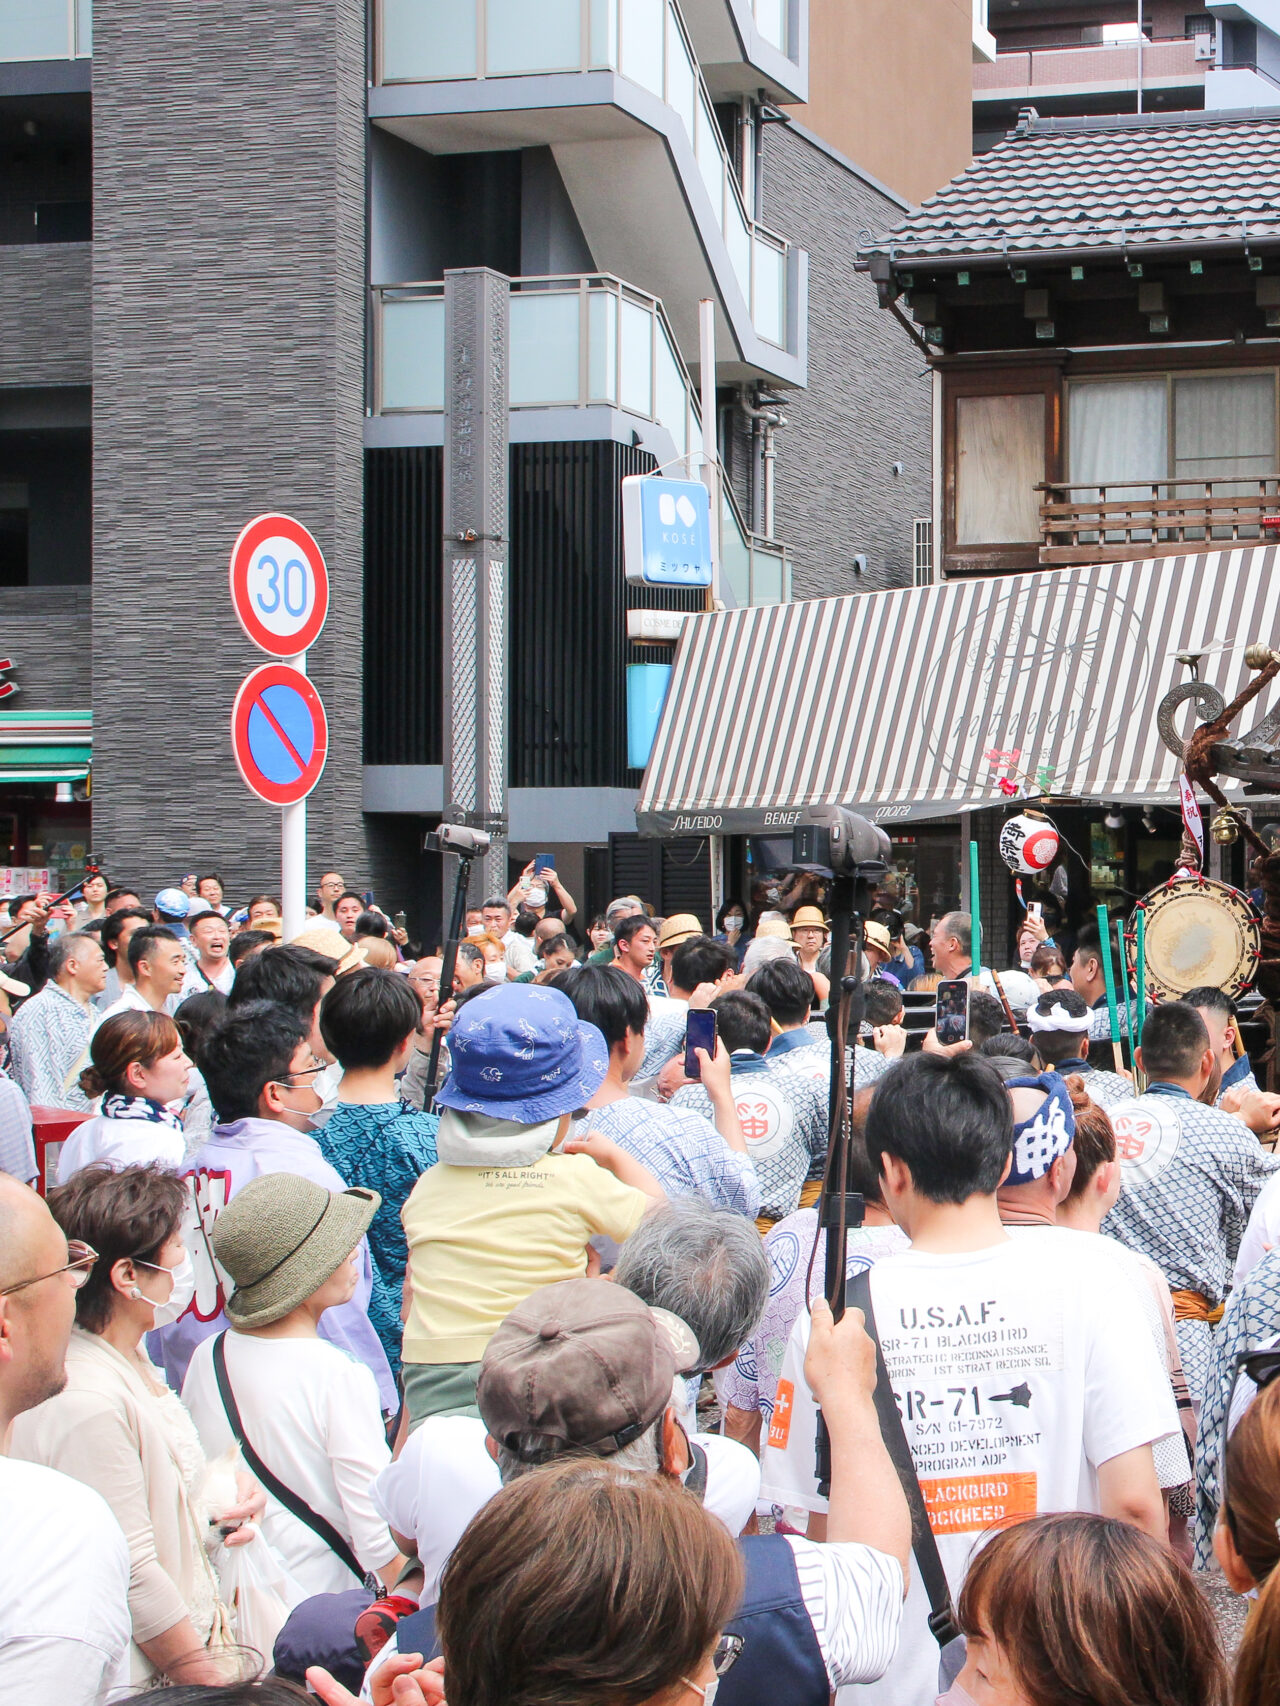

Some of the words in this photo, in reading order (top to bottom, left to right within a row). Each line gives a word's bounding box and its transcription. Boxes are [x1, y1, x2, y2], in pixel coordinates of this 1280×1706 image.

[660, 561, 701, 573] ミツワヤ
[257, 554, 307, 617] 30
[1185, 789, 1198, 819] 奉祝
[671, 815, 722, 831] SHISEIDO
[764, 811, 801, 826] BENEF
[502, 1171, 519, 1179] ALL
[900, 1300, 1006, 1330] U.S.A.F.
[881, 1337, 929, 1353] SR-71
[937, 1327, 1029, 1349] BLACKBIRD
[885, 1352, 948, 1368] STRATEGIC
[951, 1343, 1049, 1362] RECONNAISSANCE
[889, 1367, 917, 1379] DRON
[957, 1361, 992, 1375] STRAT
[996, 1358, 1032, 1371] RECON
[916, 1422, 942, 1436] S/N
[949, 1416, 1003, 1431] 61-7972
[911, 1441, 945, 1457] NCED
[951, 1432, 1042, 1452] DEVELOPMENT
[914, 1455, 977, 1473] PROGRAM
[982, 1452, 1007, 1467] ADP
[922, 1481, 1009, 1504] LACKBIRD
[927, 1504, 1005, 1527] OCKHEED
